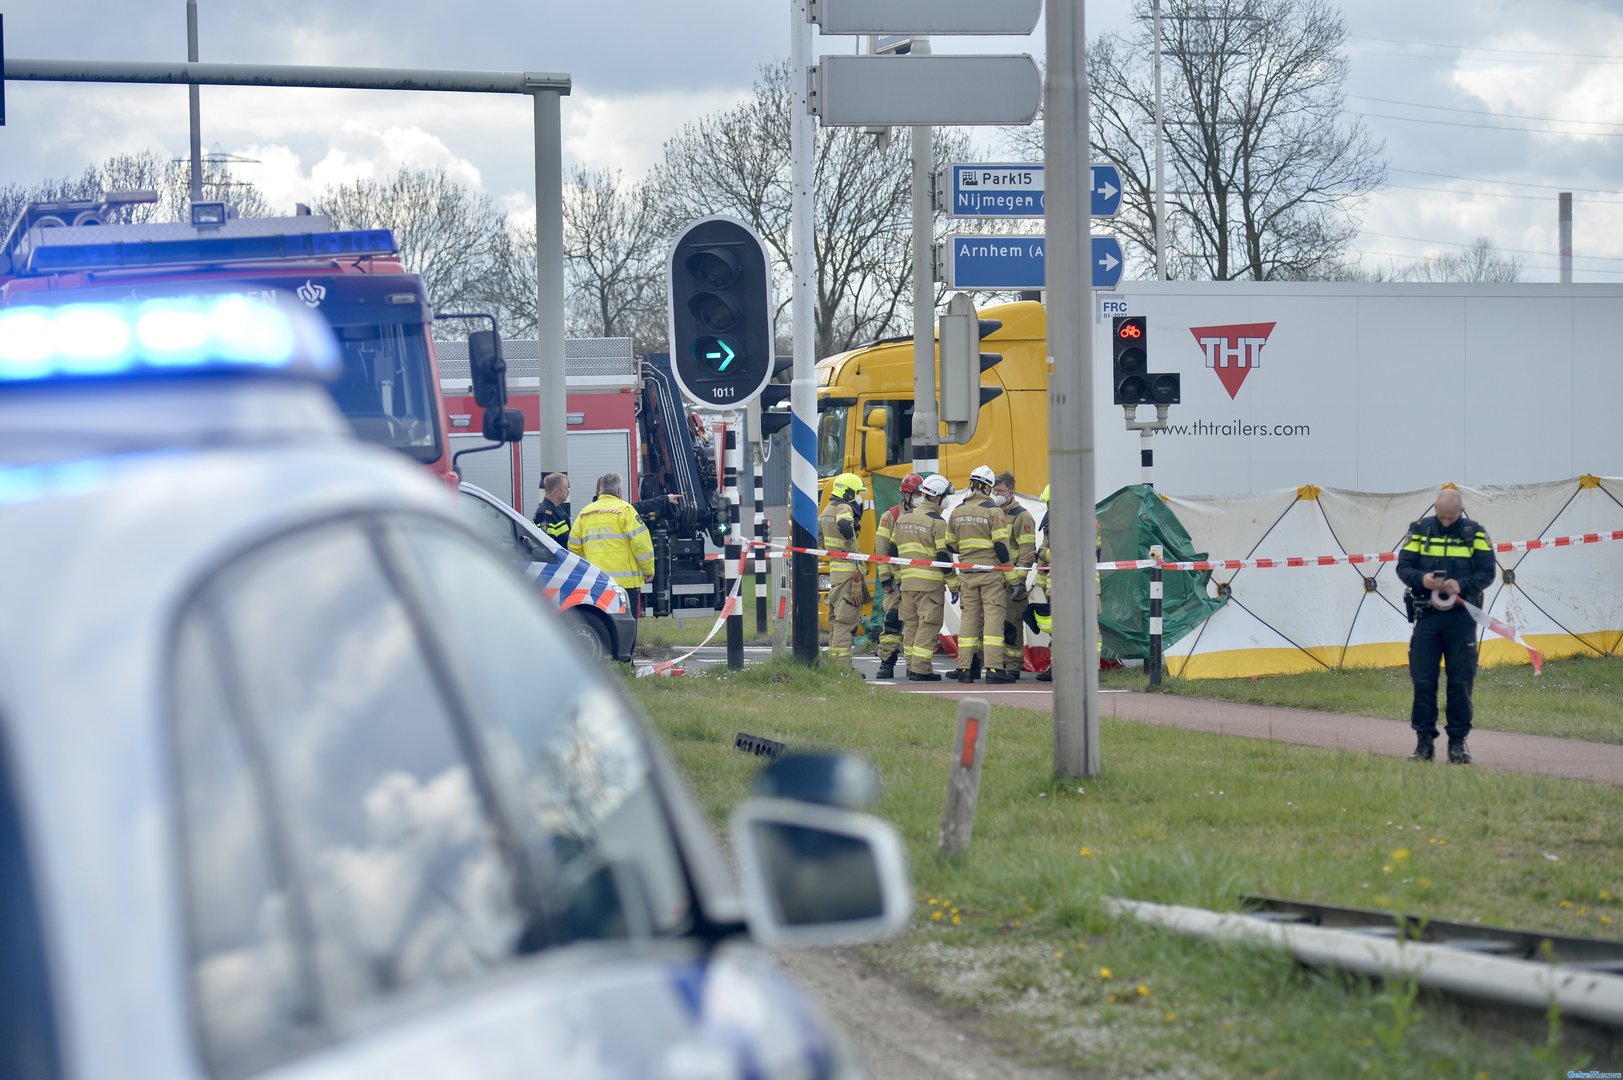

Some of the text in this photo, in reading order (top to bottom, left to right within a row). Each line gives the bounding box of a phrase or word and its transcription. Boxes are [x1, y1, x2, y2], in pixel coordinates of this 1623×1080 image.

[982, 173, 1033, 185] Park15
[958, 193, 1034, 210] Nijmegen
[959, 244, 1023, 257] Arnhem
[1103, 301, 1128, 312] FRC
[1199, 336, 1267, 369] THT
